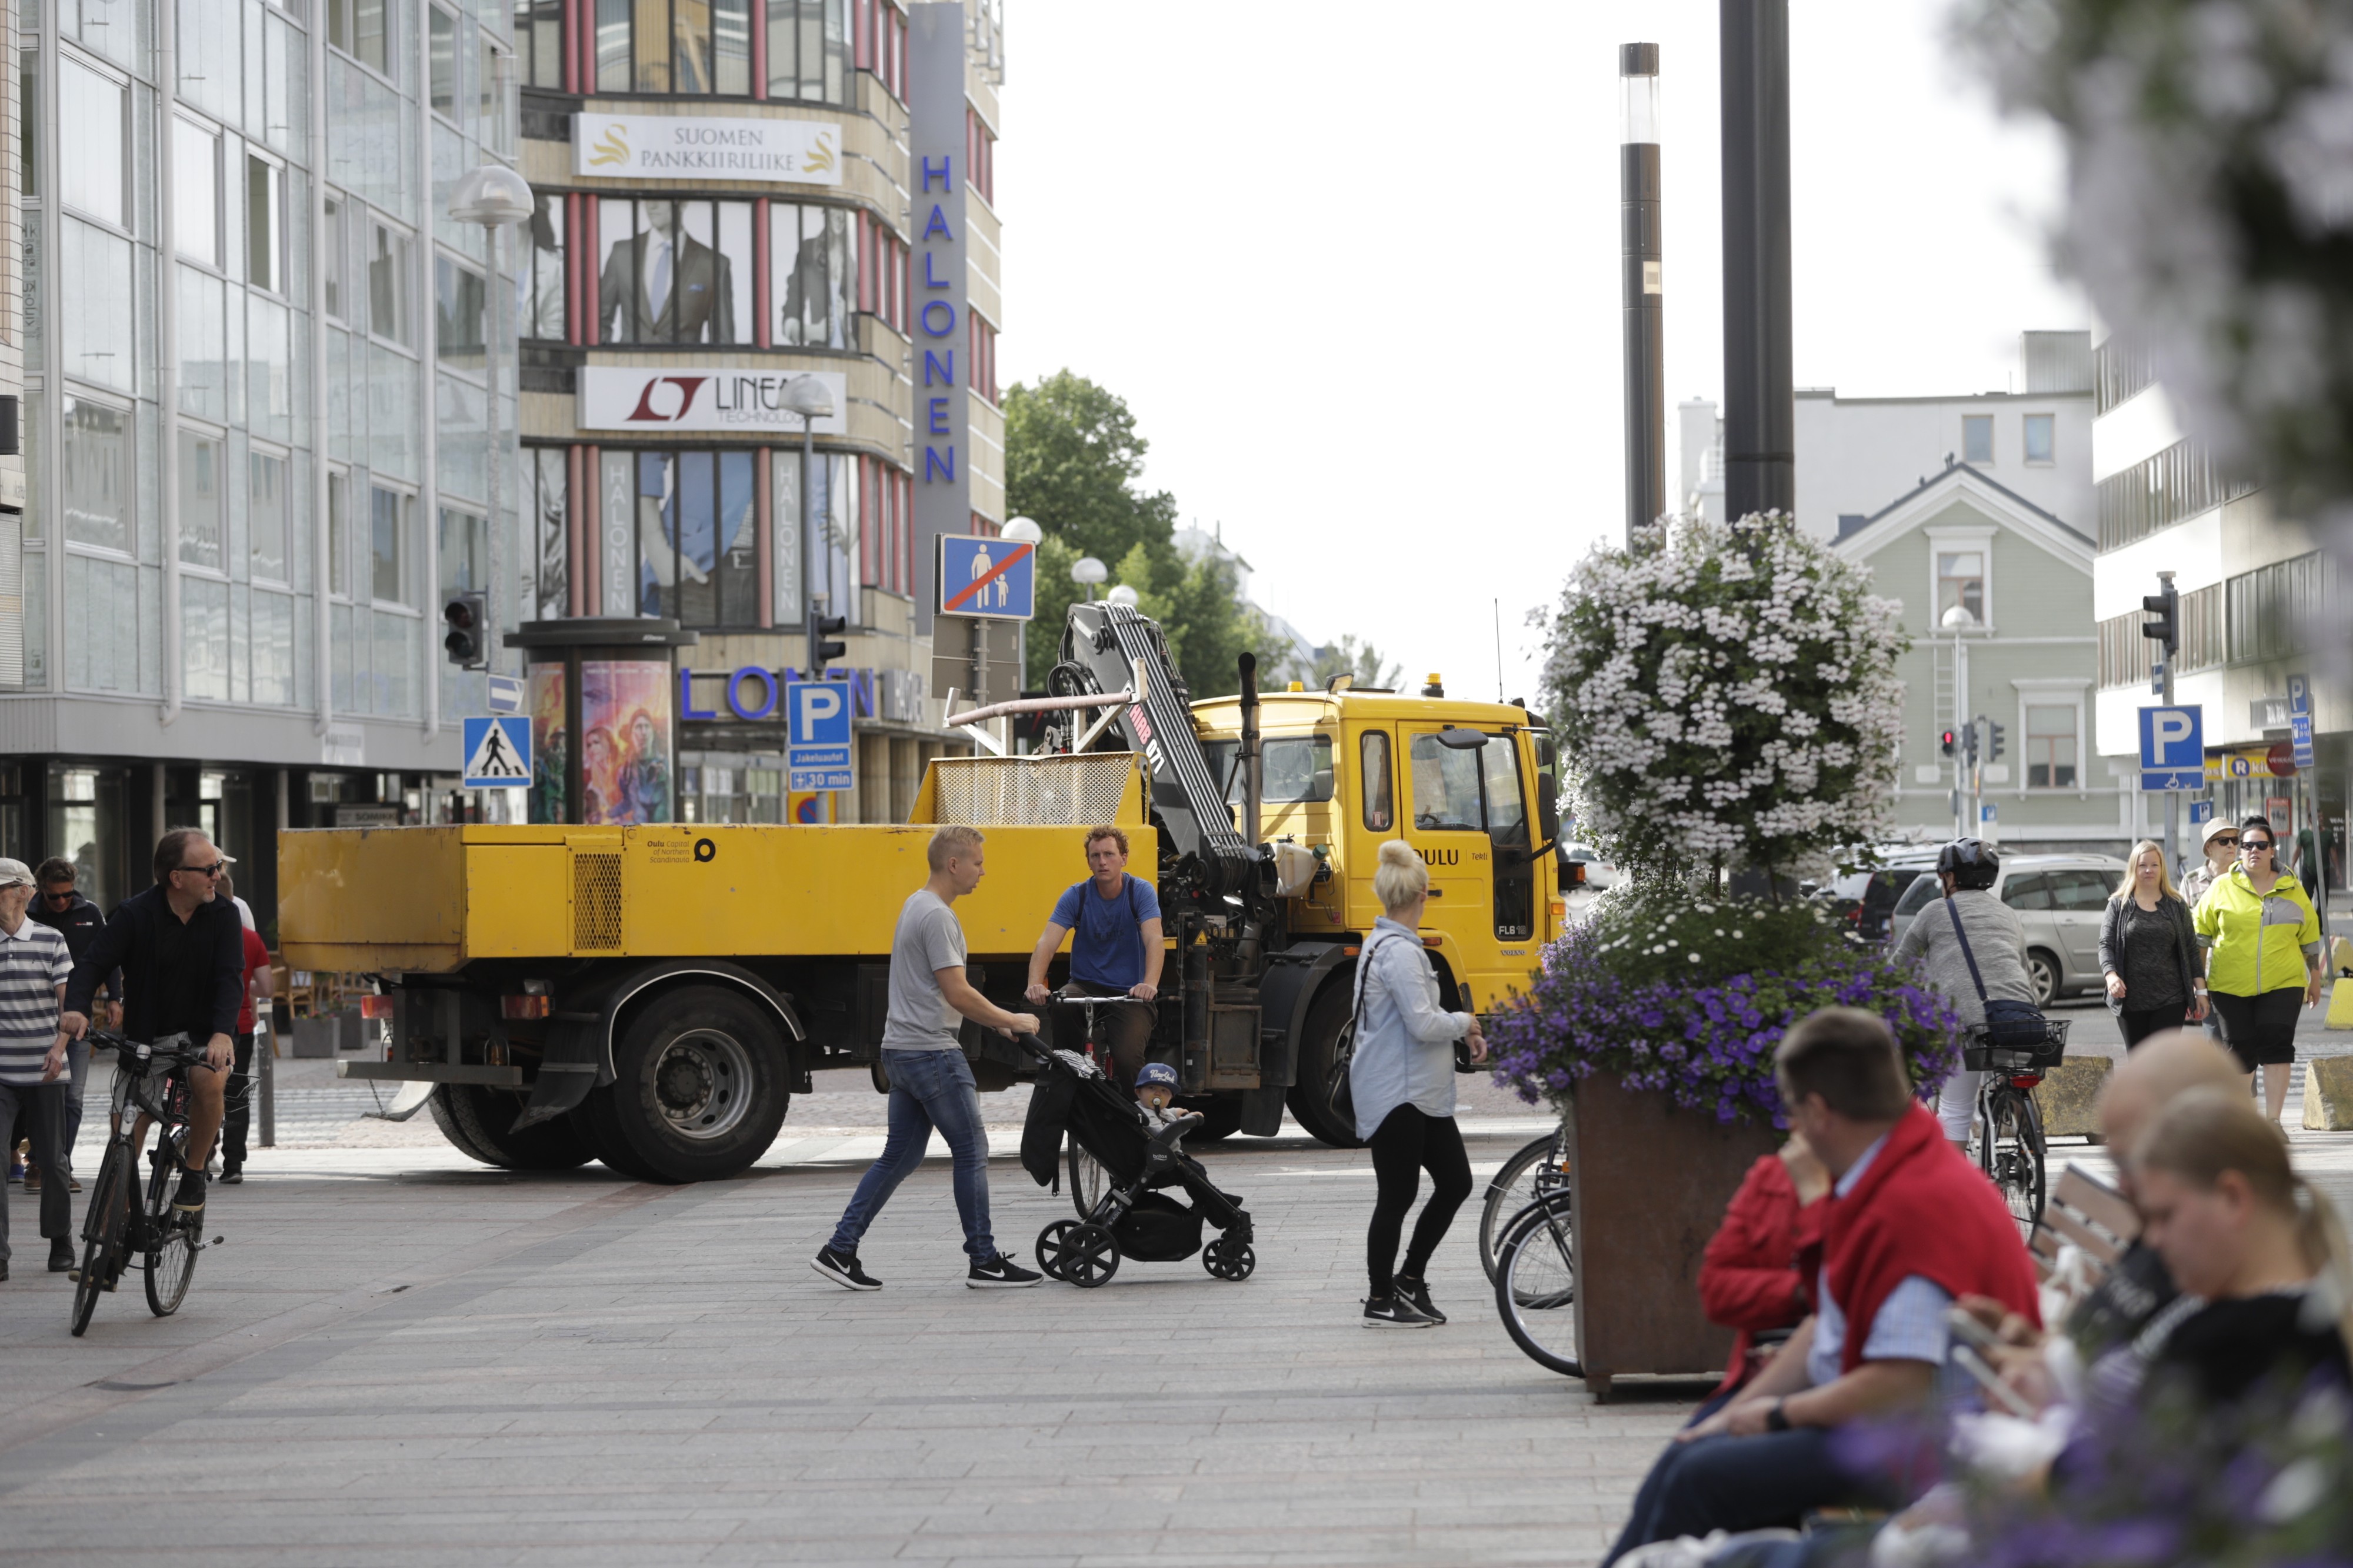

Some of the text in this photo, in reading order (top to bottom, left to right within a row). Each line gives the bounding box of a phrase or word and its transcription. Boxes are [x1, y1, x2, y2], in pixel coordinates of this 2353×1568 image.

[675, 128, 763, 145] SUOMEN
[641, 150, 794, 171] PANKKIIRILIIKE
[921, 155, 956, 482] HALONEN
[716, 377, 788, 410] LINE
[718, 412, 804, 424] TECHNOLOG
[609, 465, 628, 611] HALONEN
[779, 466, 795, 610] HALONEN
[2291, 678, 2304, 711] P
[801, 688, 841, 740] P
[2152, 710, 2193, 765] P
[1145, 739, 1165, 775] 071
[2235, 759, 2247, 774] R
[808, 772, 850, 786] 30 min
[1471, 852, 1488, 860] Tekli
[1499, 926, 1515, 935] FL6
